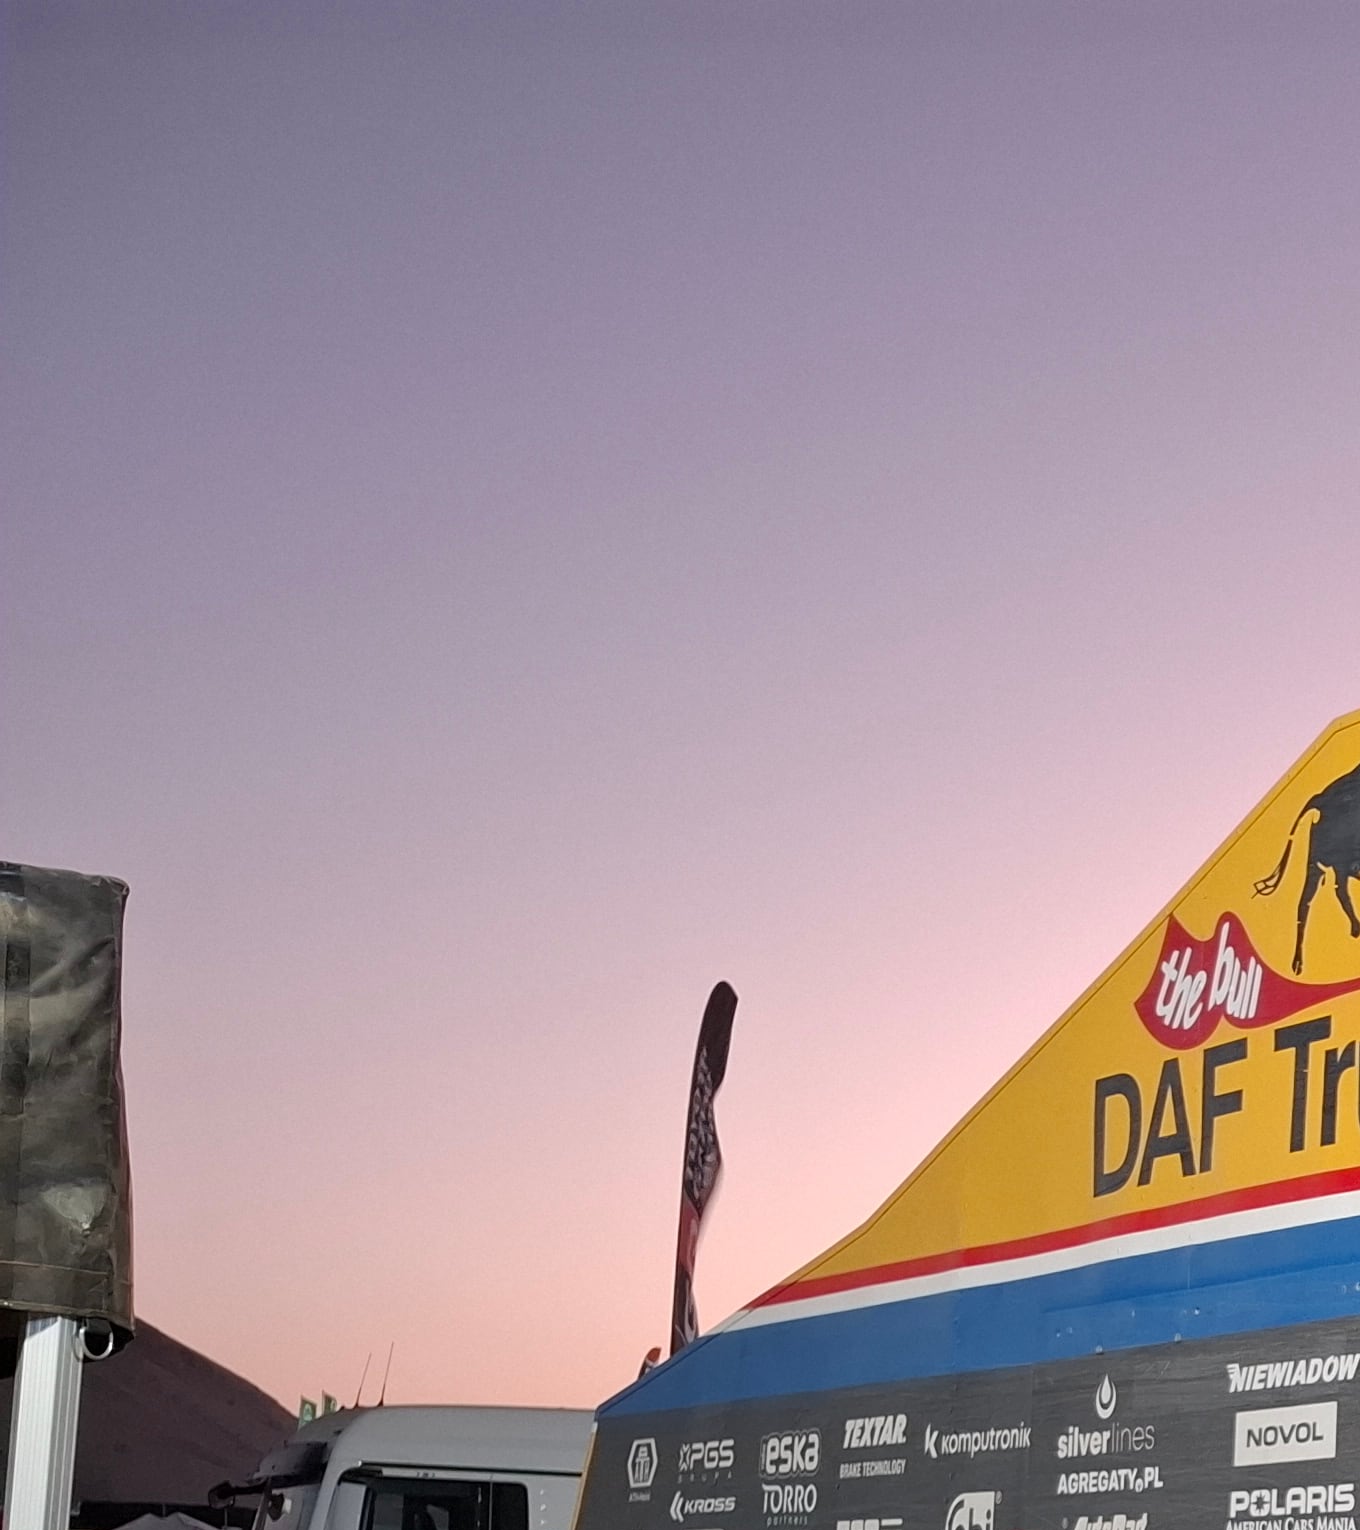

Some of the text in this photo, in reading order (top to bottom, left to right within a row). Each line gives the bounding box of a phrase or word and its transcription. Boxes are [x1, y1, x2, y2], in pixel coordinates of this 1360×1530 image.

[1155, 922, 1263, 1031] the bull
[1093, 1037, 1248, 1198] DAF
[843, 1414, 907, 1449] TEXTAR
[941, 1422, 1032, 1458] komputronik
[1246, 1421, 1324, 1449] NOVOL
[839, 1459, 907, 1479] BRAKE TECHNOLOGY
[684, 1496, 736, 1514] KROSS
[762, 1483, 818, 1514] TORRO
[1230, 1484, 1355, 1518] POLARIS
